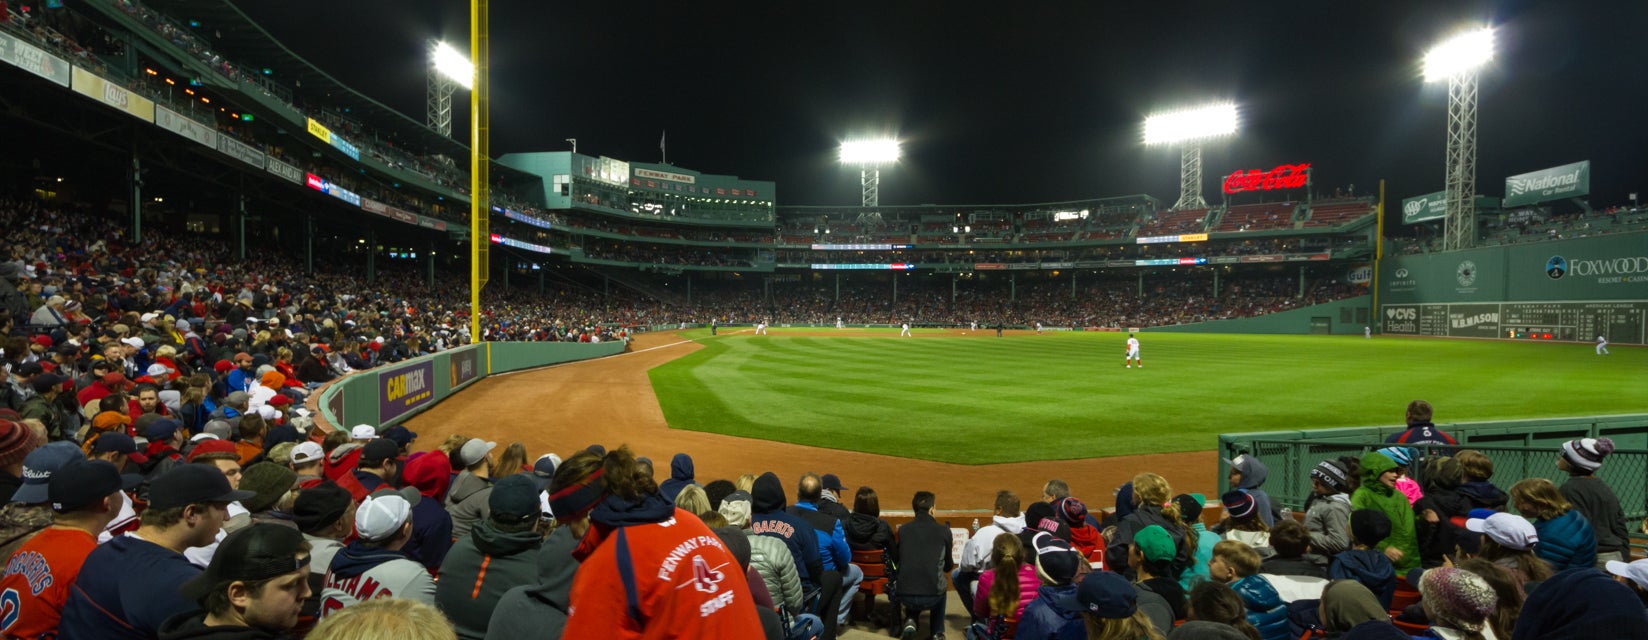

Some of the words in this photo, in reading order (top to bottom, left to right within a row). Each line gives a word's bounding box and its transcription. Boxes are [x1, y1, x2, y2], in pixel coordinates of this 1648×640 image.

[310, 122, 327, 138] STANLEY
[269, 159, 281, 172] ALEX
[282, 164, 293, 177] AND
[638, 169, 668, 179] FENWAY
[672, 174, 692, 182] PARK
[1223, 163, 1311, 194] Coca-Cola
[1524, 169, 1580, 192] National
[1542, 188, 1553, 196] Car
[1554, 184, 1576, 194] Rental
[1348, 268, 1371, 281] Gulf
[1395, 308, 1416, 320] CVS
[1387, 320, 1416, 332] Health
[753, 520, 795, 539] GAERTS
[657, 537, 700, 582] FENWAY
[699, 589, 735, 618] STAFF
